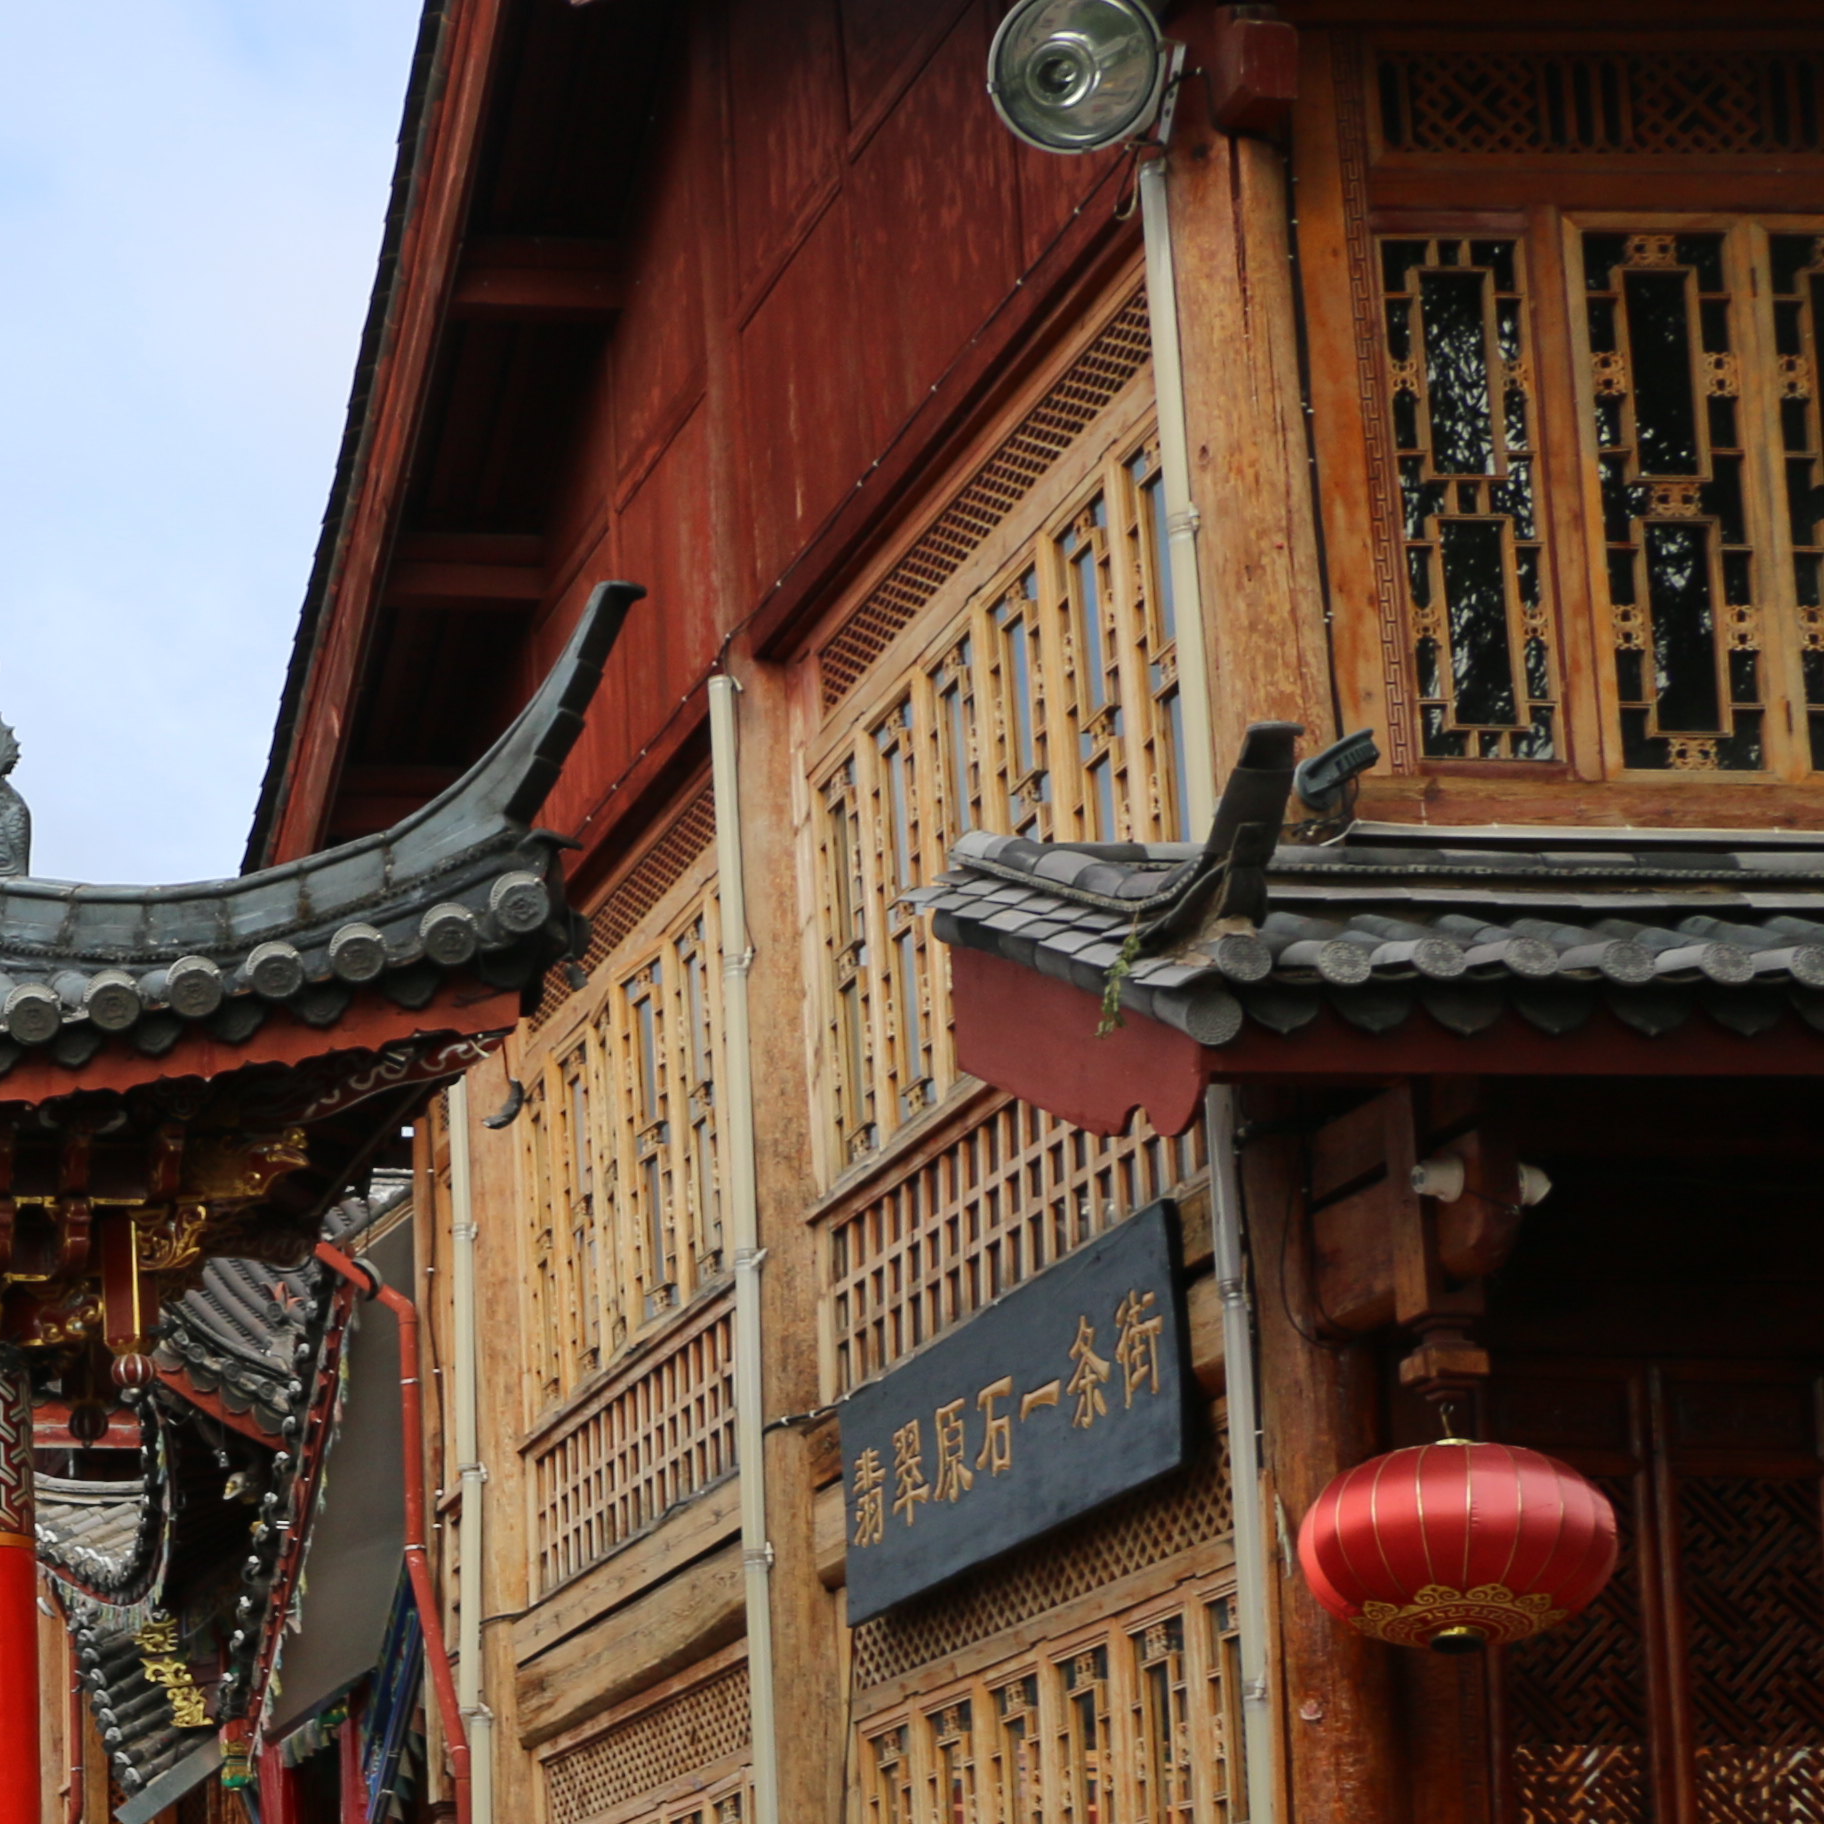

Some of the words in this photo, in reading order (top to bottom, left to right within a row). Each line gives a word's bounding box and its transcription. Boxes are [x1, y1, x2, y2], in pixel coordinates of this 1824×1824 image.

[852, 1288, 1165, 1549] 翡翠原石一条街
